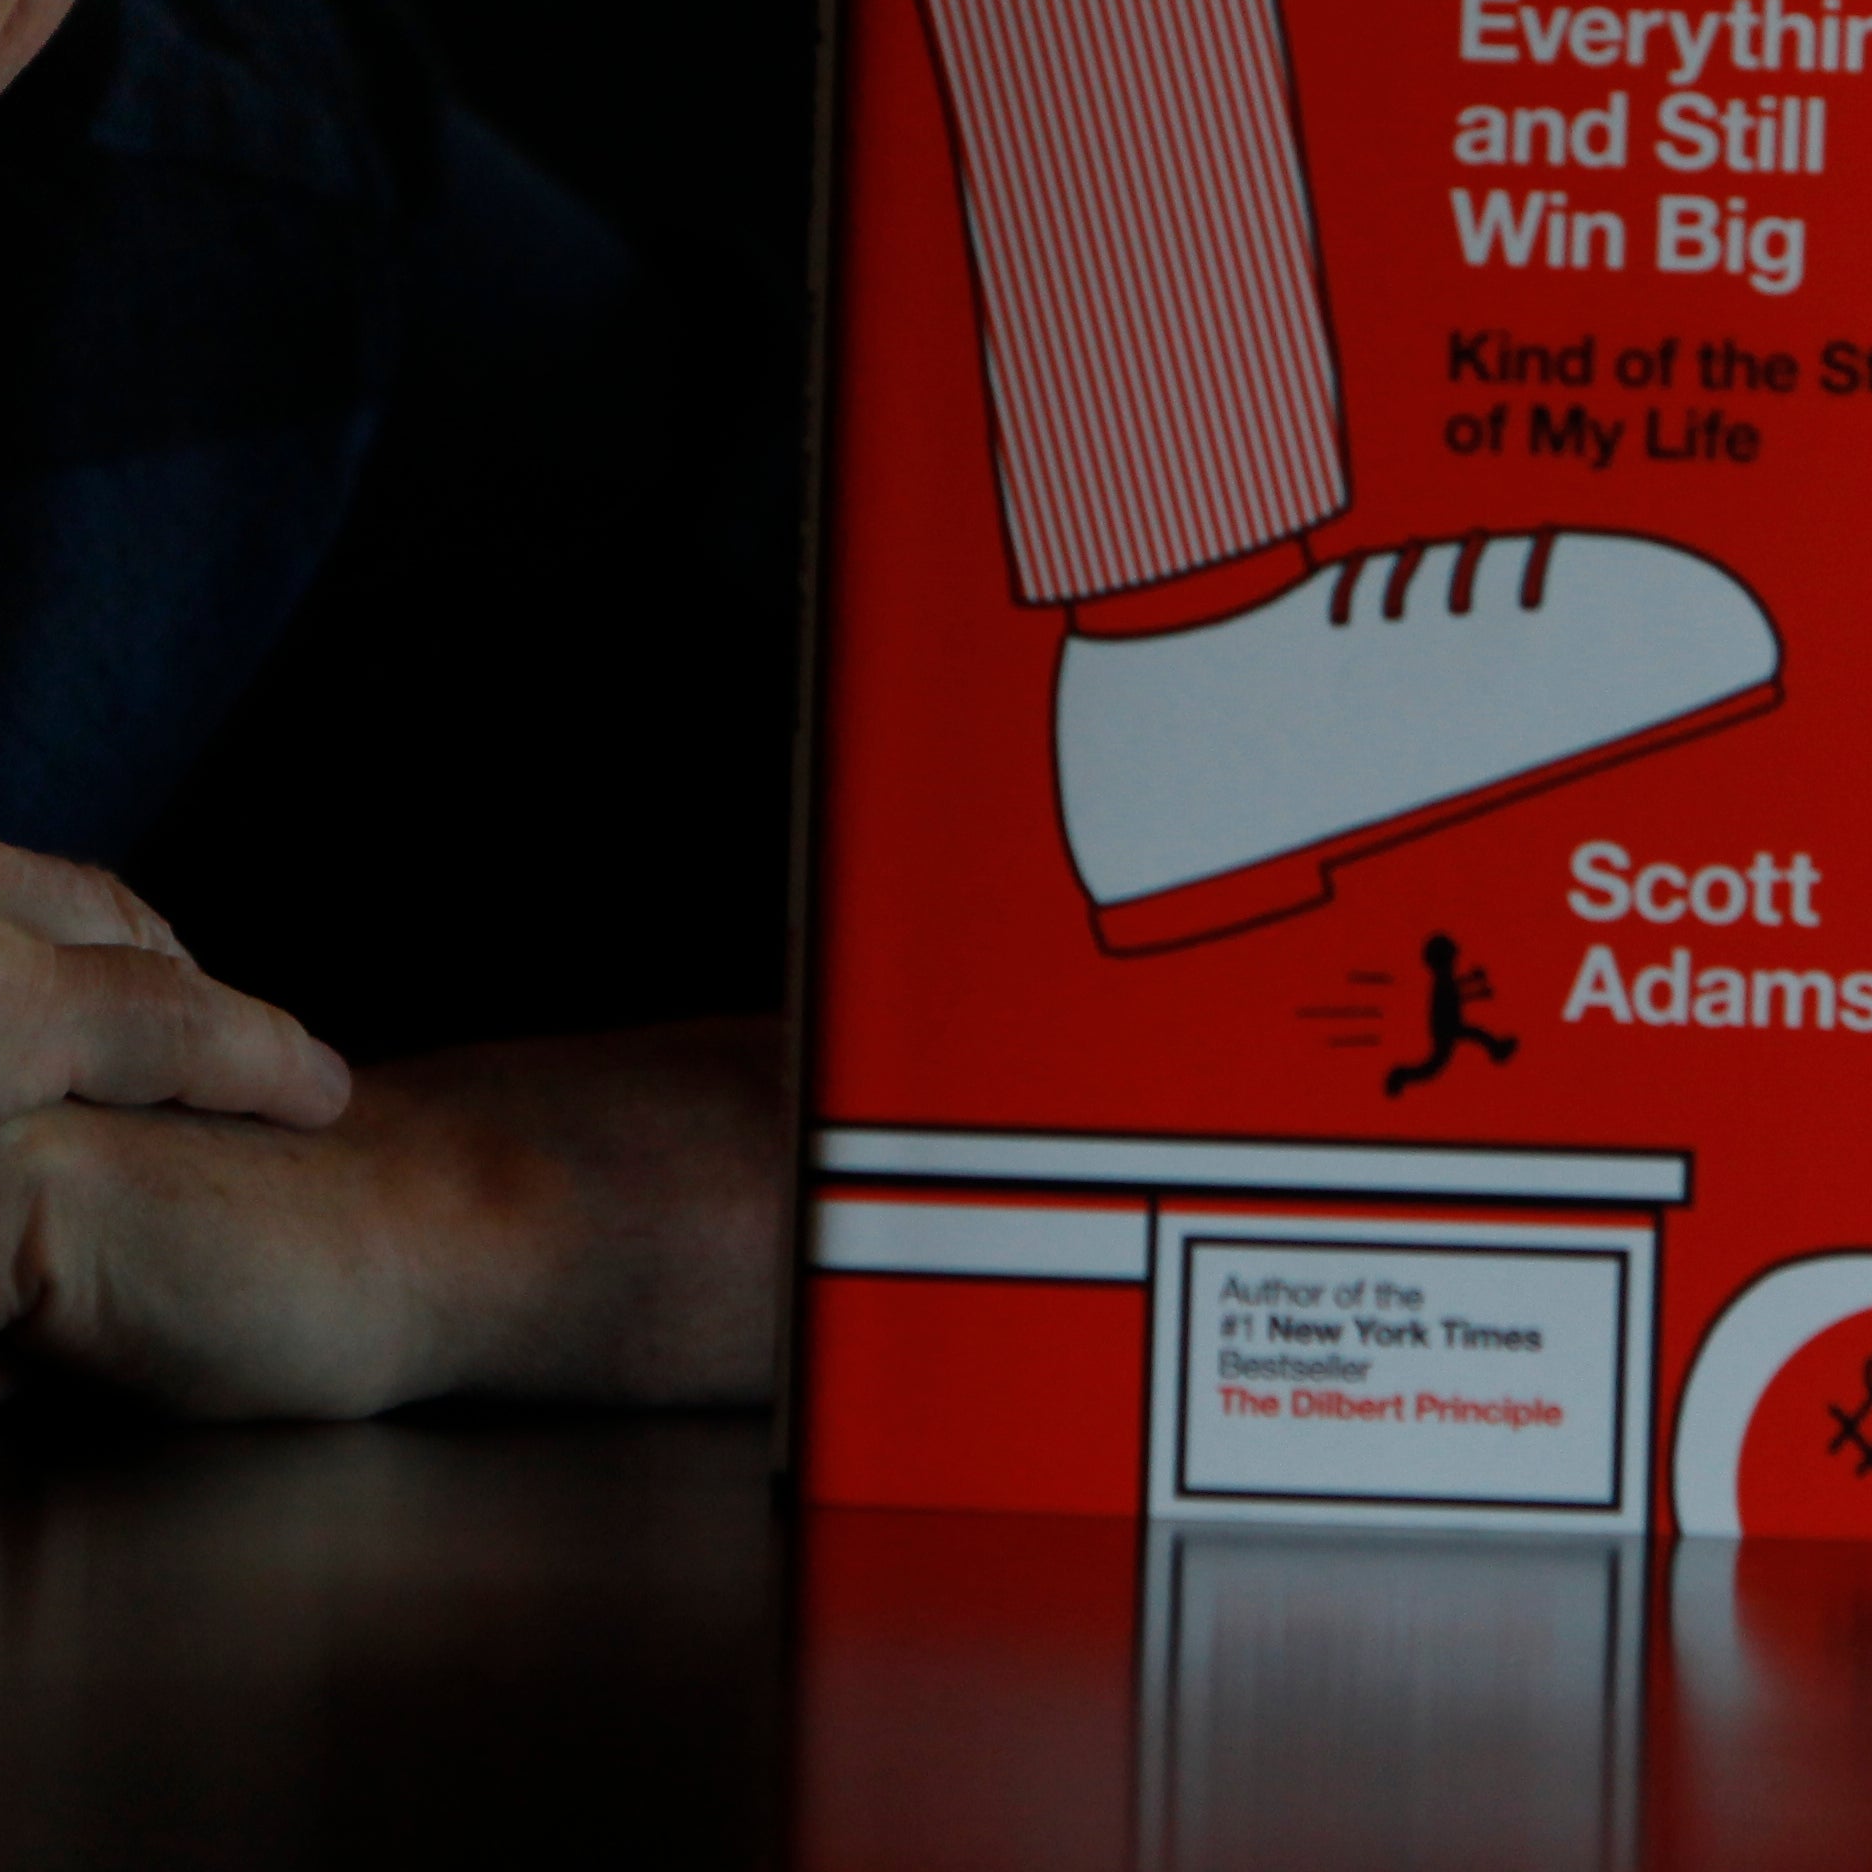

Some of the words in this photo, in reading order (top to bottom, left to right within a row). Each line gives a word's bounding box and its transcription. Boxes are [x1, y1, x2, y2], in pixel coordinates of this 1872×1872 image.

[1453, 91, 1629, 169] and
[1656, 91, 1826, 174] Still
[1451, 188, 1626, 270] Win
[1657, 194, 1806, 296] Big
[1447, 330, 1596, 388] Kind
[1614, 337, 1680, 390] of
[1696, 338, 1800, 394] the
[1443, 403, 1510, 456] of
[1529, 403, 1625, 470] My
[1644, 407, 1761, 464] Life
[1568, 841, 1821, 928] Scott
[1220, 1275, 1324, 1307] Author
[1333, 1279, 1365, 1306] of
[1374, 1280, 1424, 1308] the
[1220, 1314, 1253, 1337] #1
[1267, 1314, 1342, 1342] New
[1354, 1317, 1428, 1345] York
[1440, 1318, 1542, 1351] Times
[1218, 1349, 1369, 1381] Bestseller
[1219, 1386, 1281, 1416] The
[1291, 1389, 1404, 1419] Dilbert
[1414, 1392, 1564, 1430] Principle
